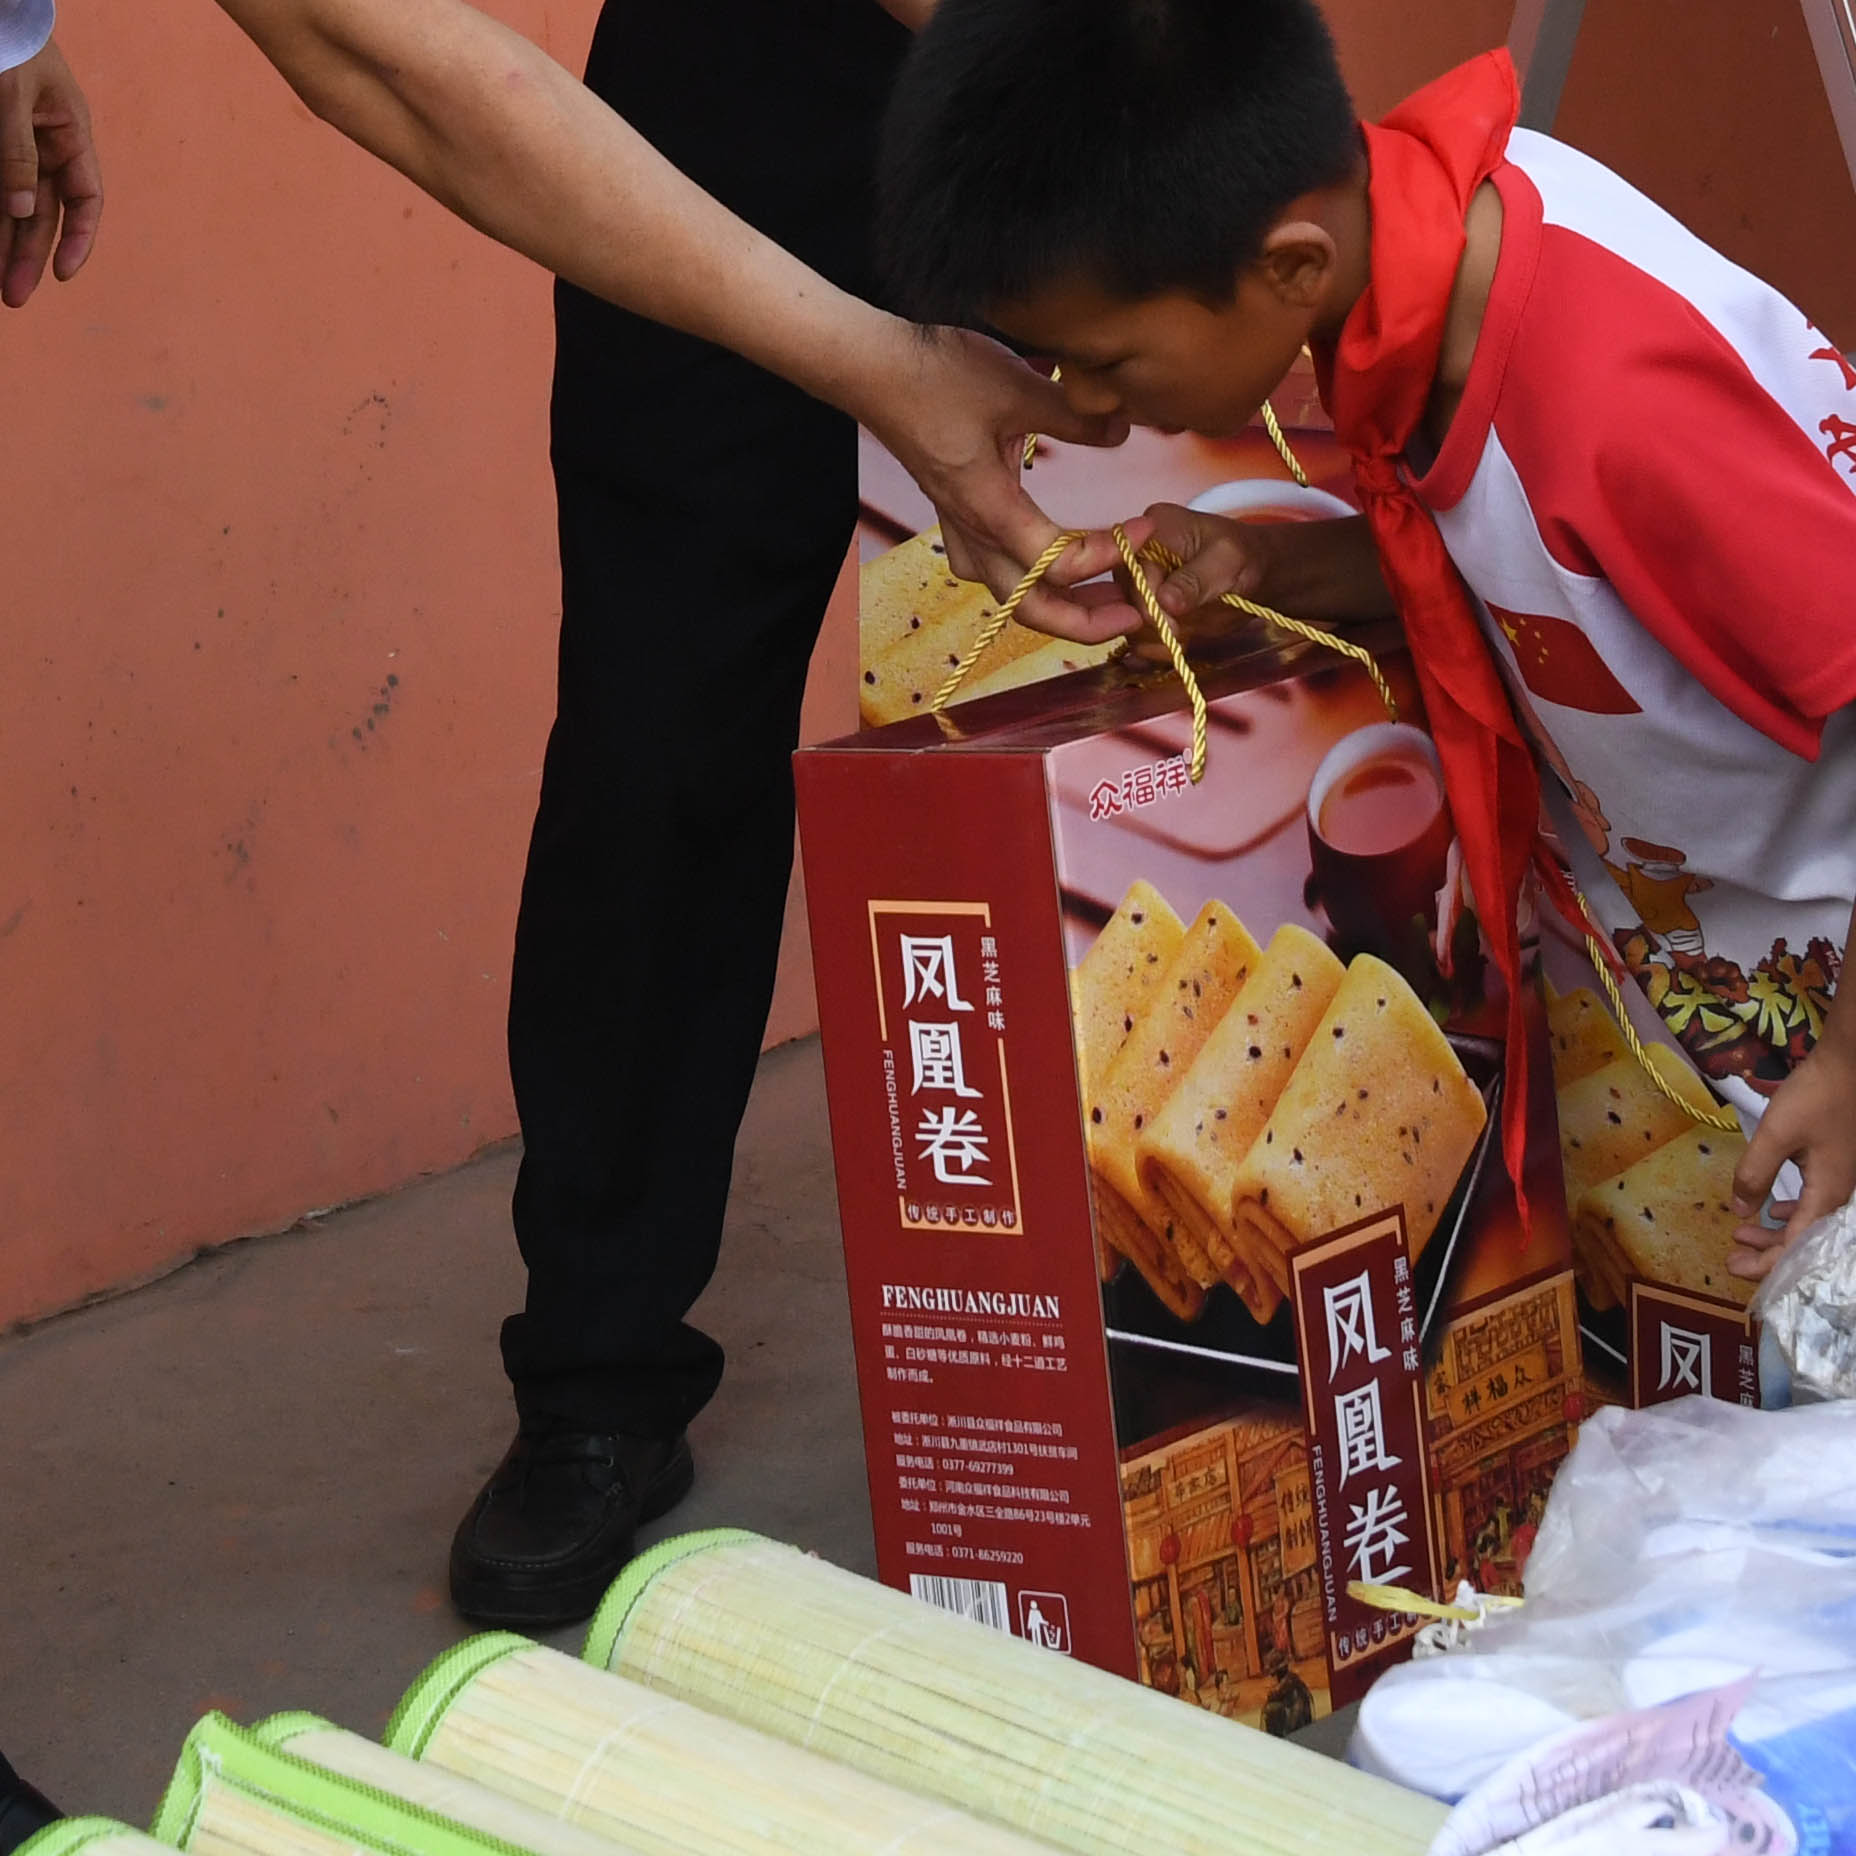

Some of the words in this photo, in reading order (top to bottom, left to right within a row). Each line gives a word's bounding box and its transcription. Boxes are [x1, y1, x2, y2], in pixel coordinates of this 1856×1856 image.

[1090, 755, 1187, 821] 众福祥
[981, 936, 1005, 1030] 黑芝麻味
[900, 933, 993, 1185] 凤凰卷
[882, 1049, 907, 1190] FENGHUANGJUAN
[907, 1203, 1016, 1227] 传统手工制作
[882, 1284, 1060, 1319] FENGHUANGJUAN
[1393, 1255, 1419, 1371] 黑芝麻味
[1322, 1269, 1413, 1585] 凤凰卷
[1312, 1444, 1337, 1622] FENGHUANGJUAN
